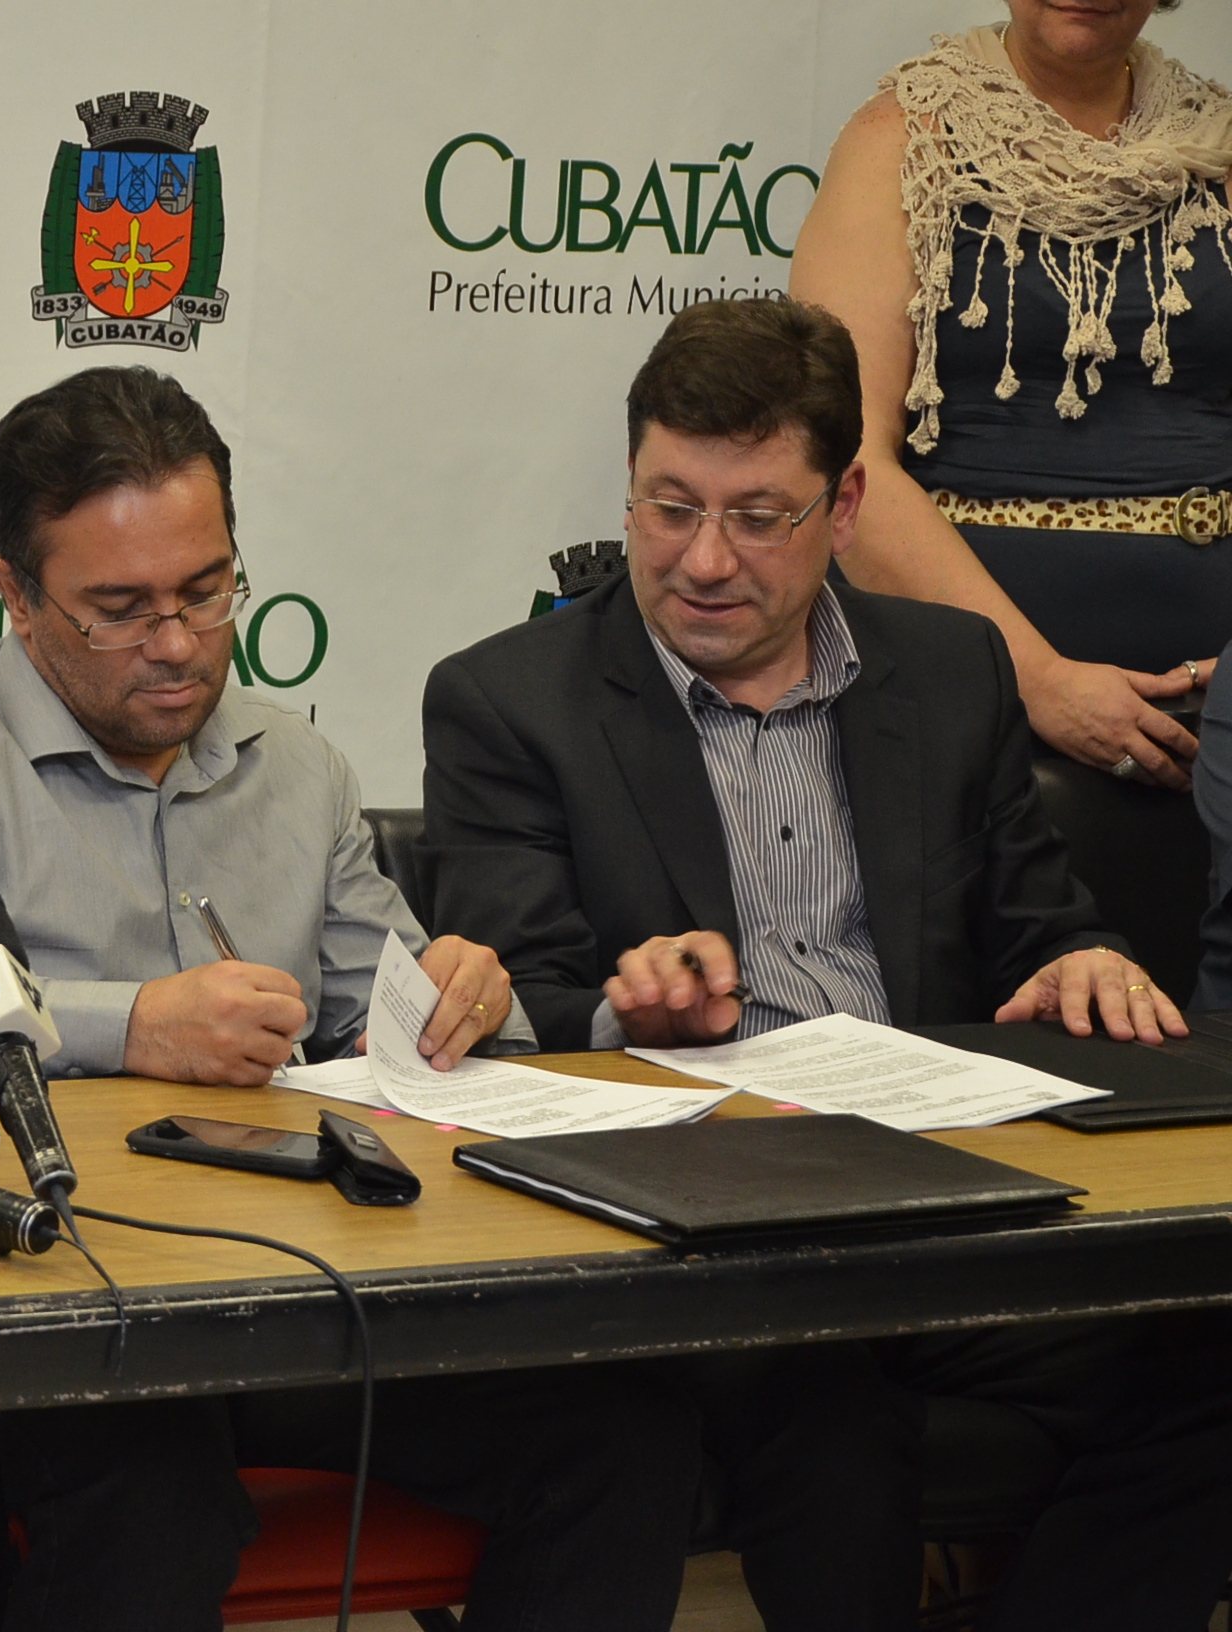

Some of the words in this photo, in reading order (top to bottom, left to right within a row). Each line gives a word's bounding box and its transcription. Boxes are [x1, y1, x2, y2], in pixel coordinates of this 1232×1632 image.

[424, 132, 821, 259] CUBATÃO
[34, 296, 84, 315] 1833
[429, 268, 612, 315] Prefeitura
[71, 323, 186, 346] CUBATÃO
